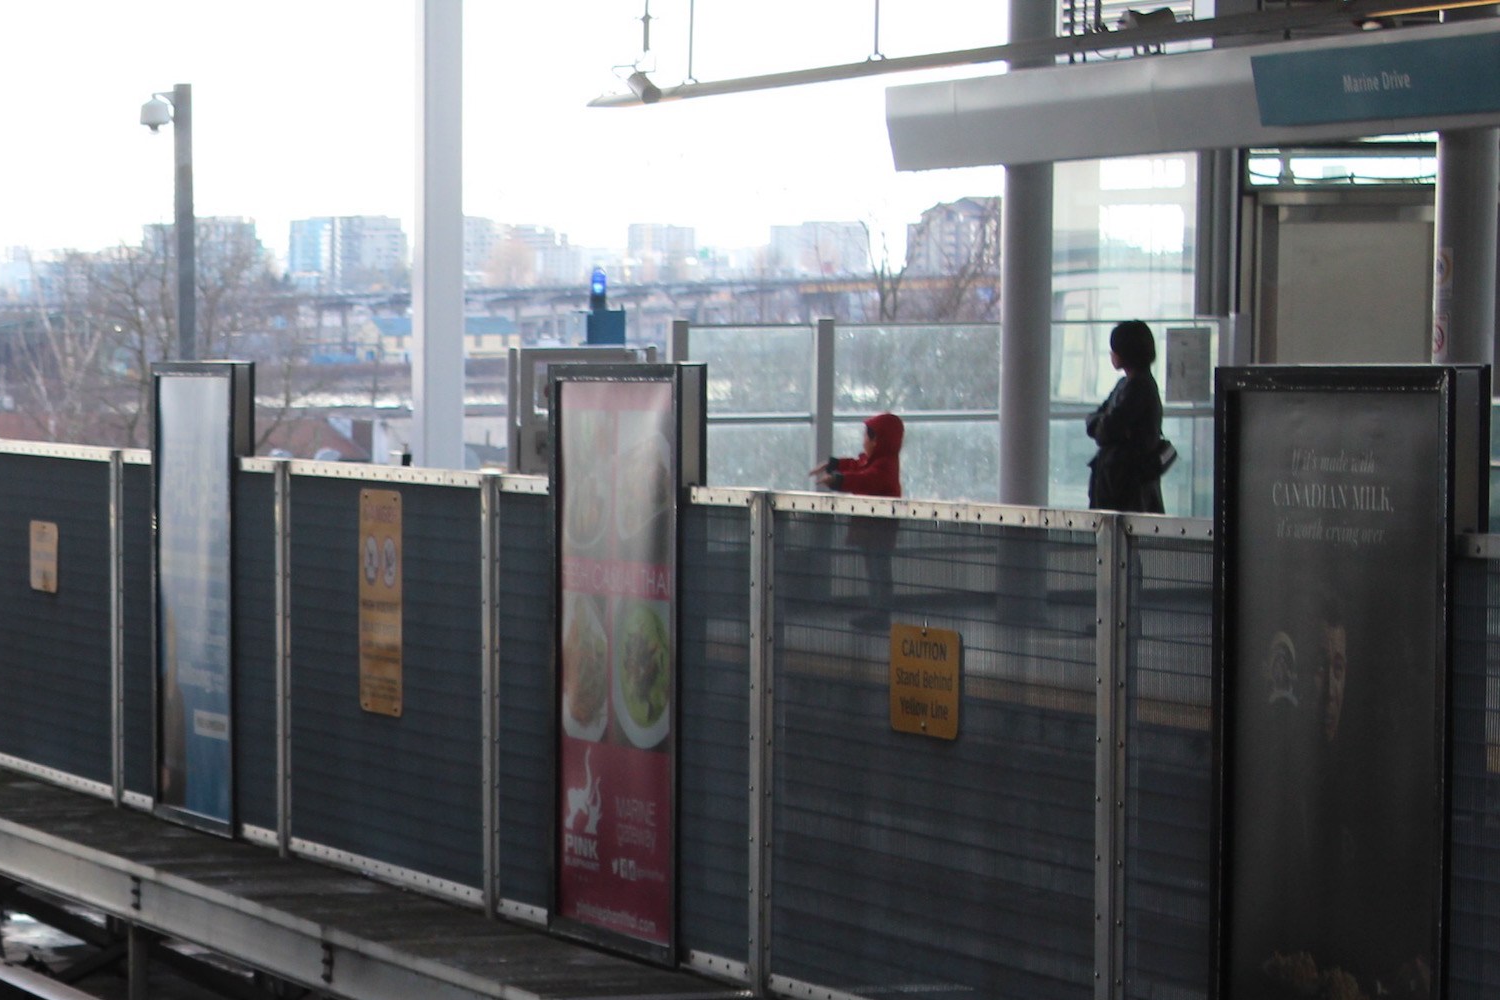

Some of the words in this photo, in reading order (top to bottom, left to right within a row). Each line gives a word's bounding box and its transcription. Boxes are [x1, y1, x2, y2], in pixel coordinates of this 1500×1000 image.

[1343, 72, 1380, 93] Marine
[1381, 70, 1411, 90] Drive
[1320, 449, 1349, 473] made
[1350, 450, 1376, 474] with
[1272, 480, 1349, 509] CANADIAN
[1352, 485, 1396, 513] MILK,
[1293, 518, 1324, 541] worth
[1325, 521, 1359, 546] crying
[901, 639, 947, 661] CAUTION
[896, 667, 921, 688] Stand
[922, 670, 953, 691] Behind
[900, 696, 929, 716] Yellow
[930, 699, 949, 720] Line
[615, 796, 656, 828] MARINE
[564, 832, 599, 860] PINK
